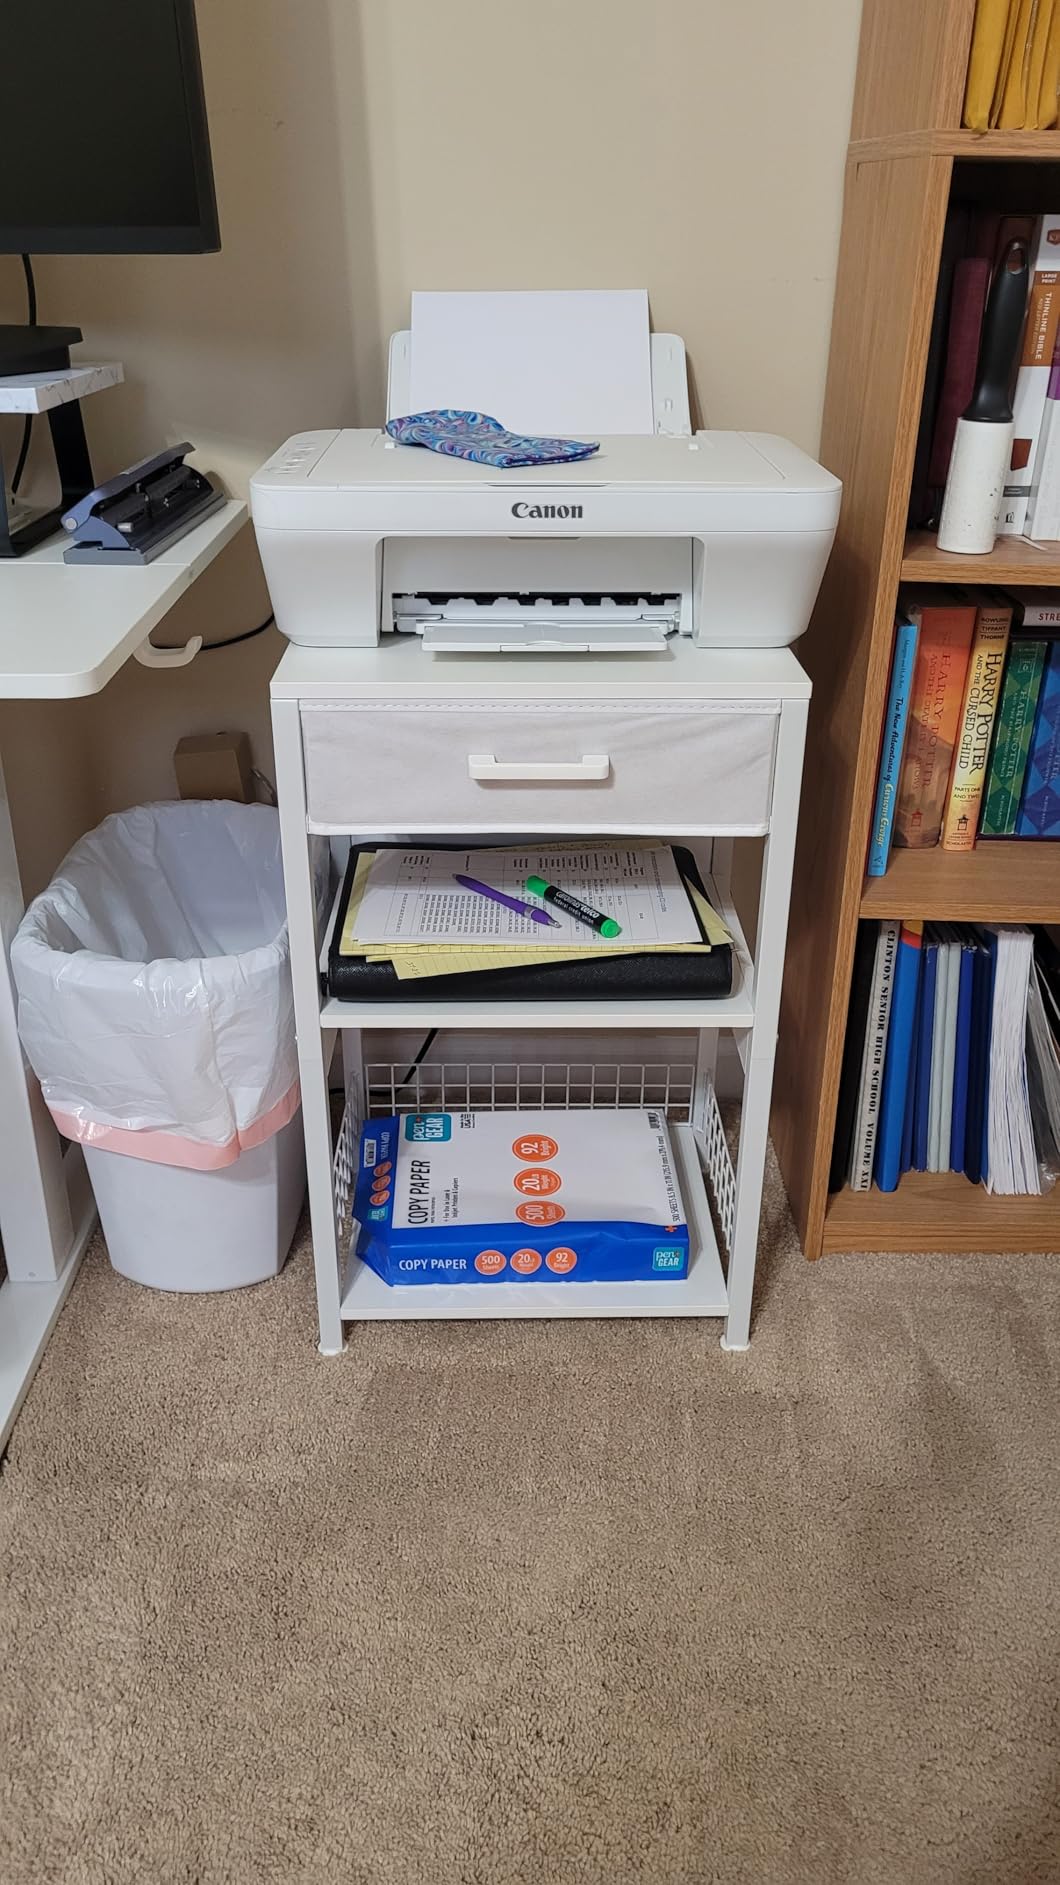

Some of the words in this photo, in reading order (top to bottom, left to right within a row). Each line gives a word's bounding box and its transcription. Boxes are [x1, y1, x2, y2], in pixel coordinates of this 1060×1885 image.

[1039, 292, 1053, 333] THINLINE
[1035, 334, 1046, 360] BIBLE
[511, 501, 584, 521] Canon
[976, 654, 984, 670] AND
[934, 654, 951, 719] HARRY
[973, 670, 981, 685] THE
[978, 652, 1003, 709] HARRY
[896, 697, 904, 712] The
[964, 687, 981, 731] CURSED
[1014, 690, 1027, 733] HARRY
[893, 713, 902, 729] New
[886, 730, 899, 773] Adventures
[958, 733, 973, 769] CHILD
[969, 711, 993, 775] POTTER
[1005, 736, 1019, 778] POTTER
[882, 773, 891, 782] of
[882, 783, 894, 816] Curious
[875, 817, 889, 847] George
[882, 930, 896, 982] CLINTON
[877, 986, 889, 1031] SENIOR
[873, 1036, 883, 1065] HIGH
[867, 1069, 880, 1116] SCHOOL
[412, 1121, 430, 1141] pen
[425, 1117, 444, 1138] GEAR
[520, 1142, 539, 1154] 92
[862, 1122, 875, 1167] VOLUME
[410, 1159, 431, 1195] PAPER
[521, 1178, 541, 1191] 20
[859, 1170, 870, 1190] XXI
[408, 1197, 429, 1225] COPY
[525, 1204, 545, 1220] 500
[668, 1199, 679, 1214] SHEETS
[672, 1213, 681, 1222] 500
[398, 1259, 427, 1271] COPY
[430, 1258, 467, 1270] PAPER
[481, 1255, 501, 1265] 500
[517, 1253, 530, 1264] 20
[555, 1252, 568, 1264] 92
[656, 1251, 675, 1261] pen
[658, 1257, 680, 1268] GEAR
